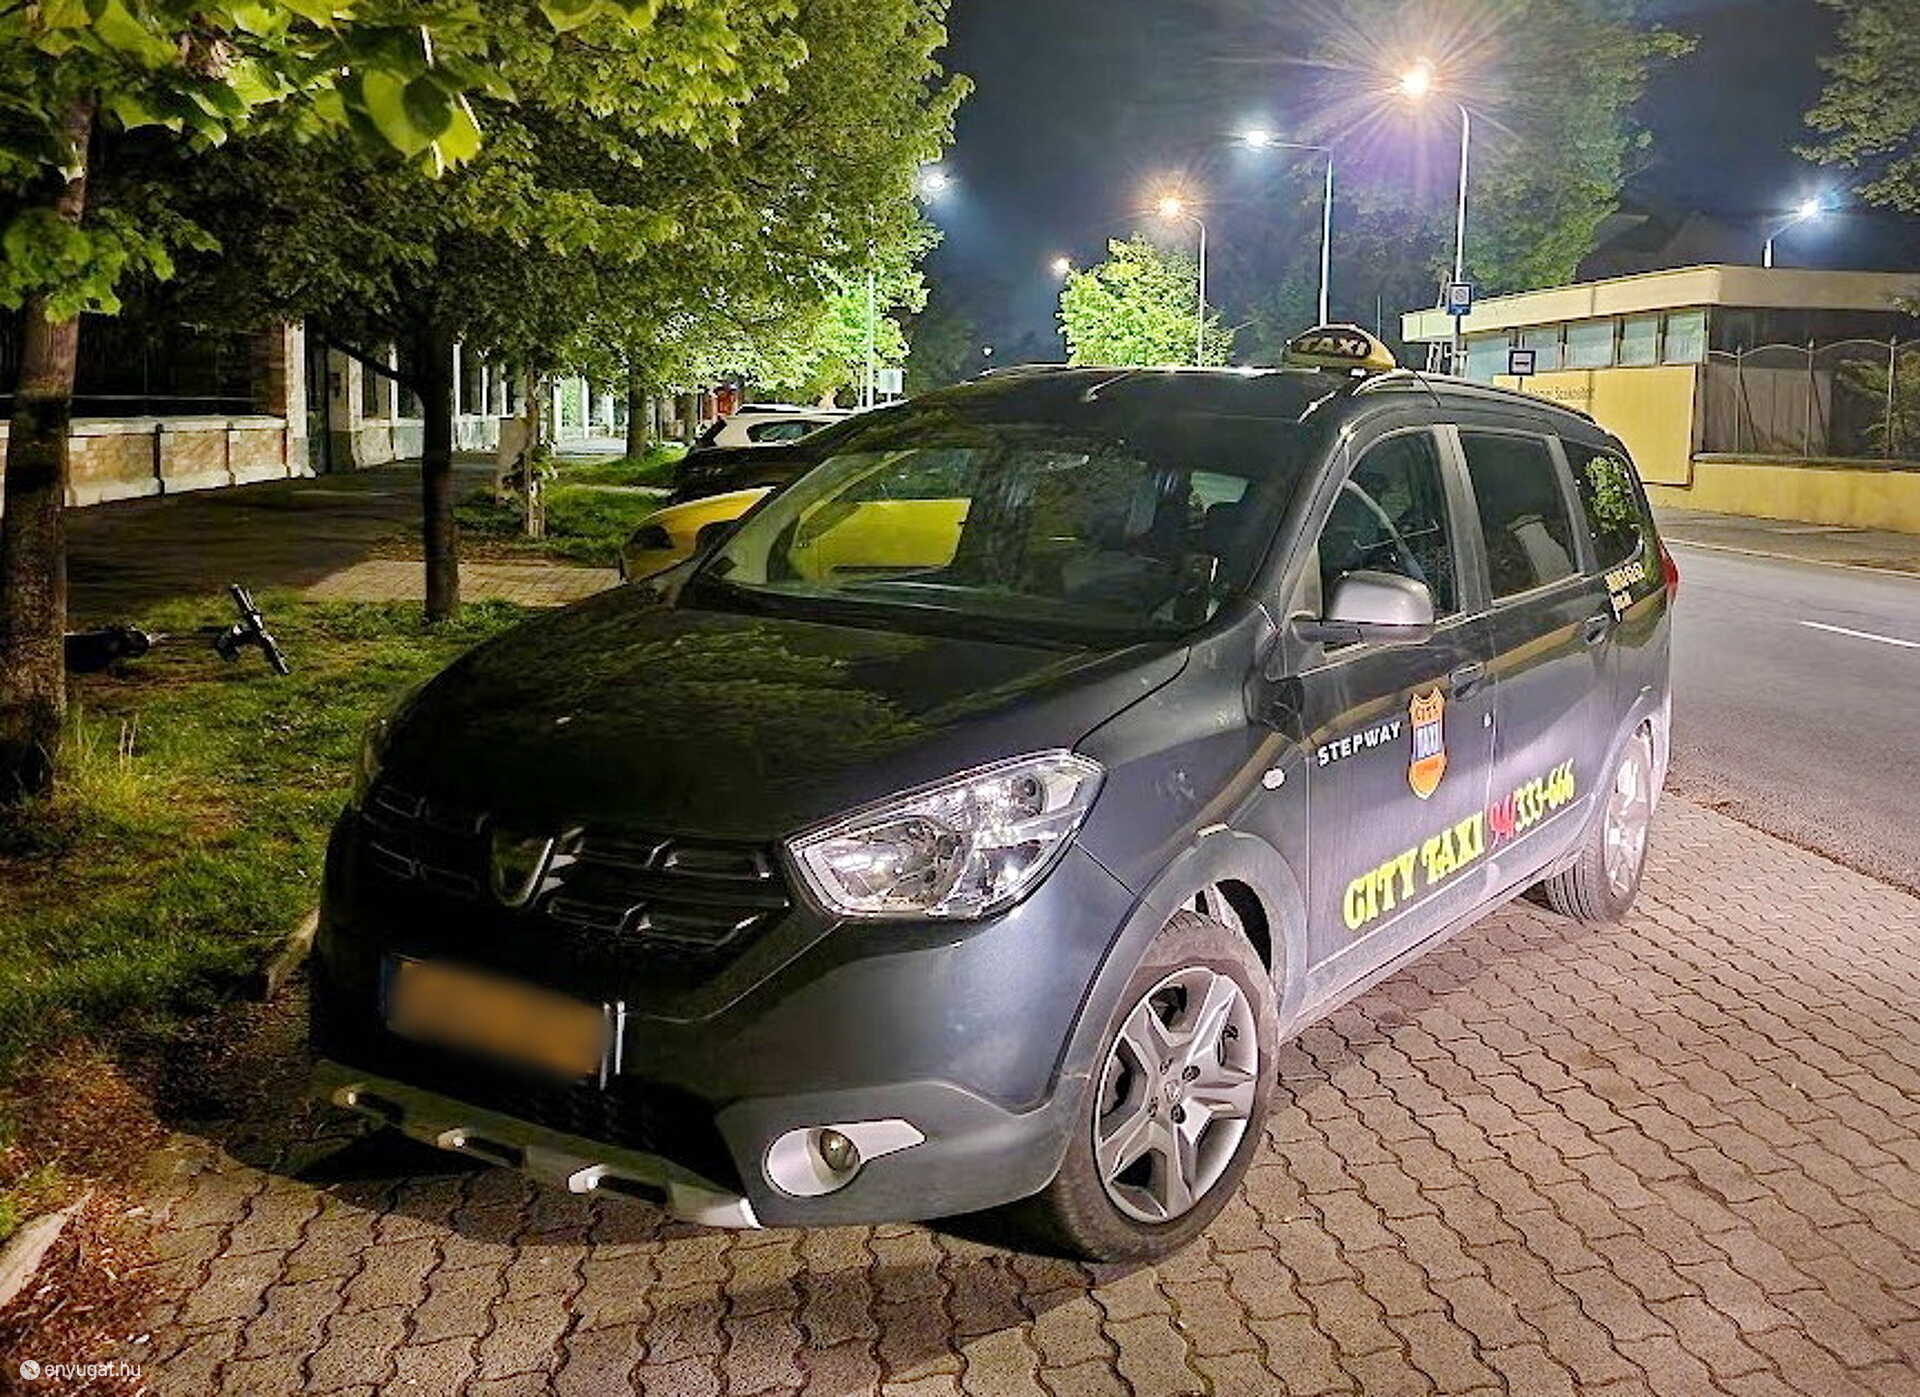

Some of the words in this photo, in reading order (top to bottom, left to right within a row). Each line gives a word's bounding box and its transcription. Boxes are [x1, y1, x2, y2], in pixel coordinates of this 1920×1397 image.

[1293, 336, 1369, 357] TAXI
[1317, 720, 1401, 767] STEPWAY
[1416, 723, 1440, 759] TAXI
[1343, 847, 1418, 930] CITY
[1421, 811, 1485, 885] TAXI
